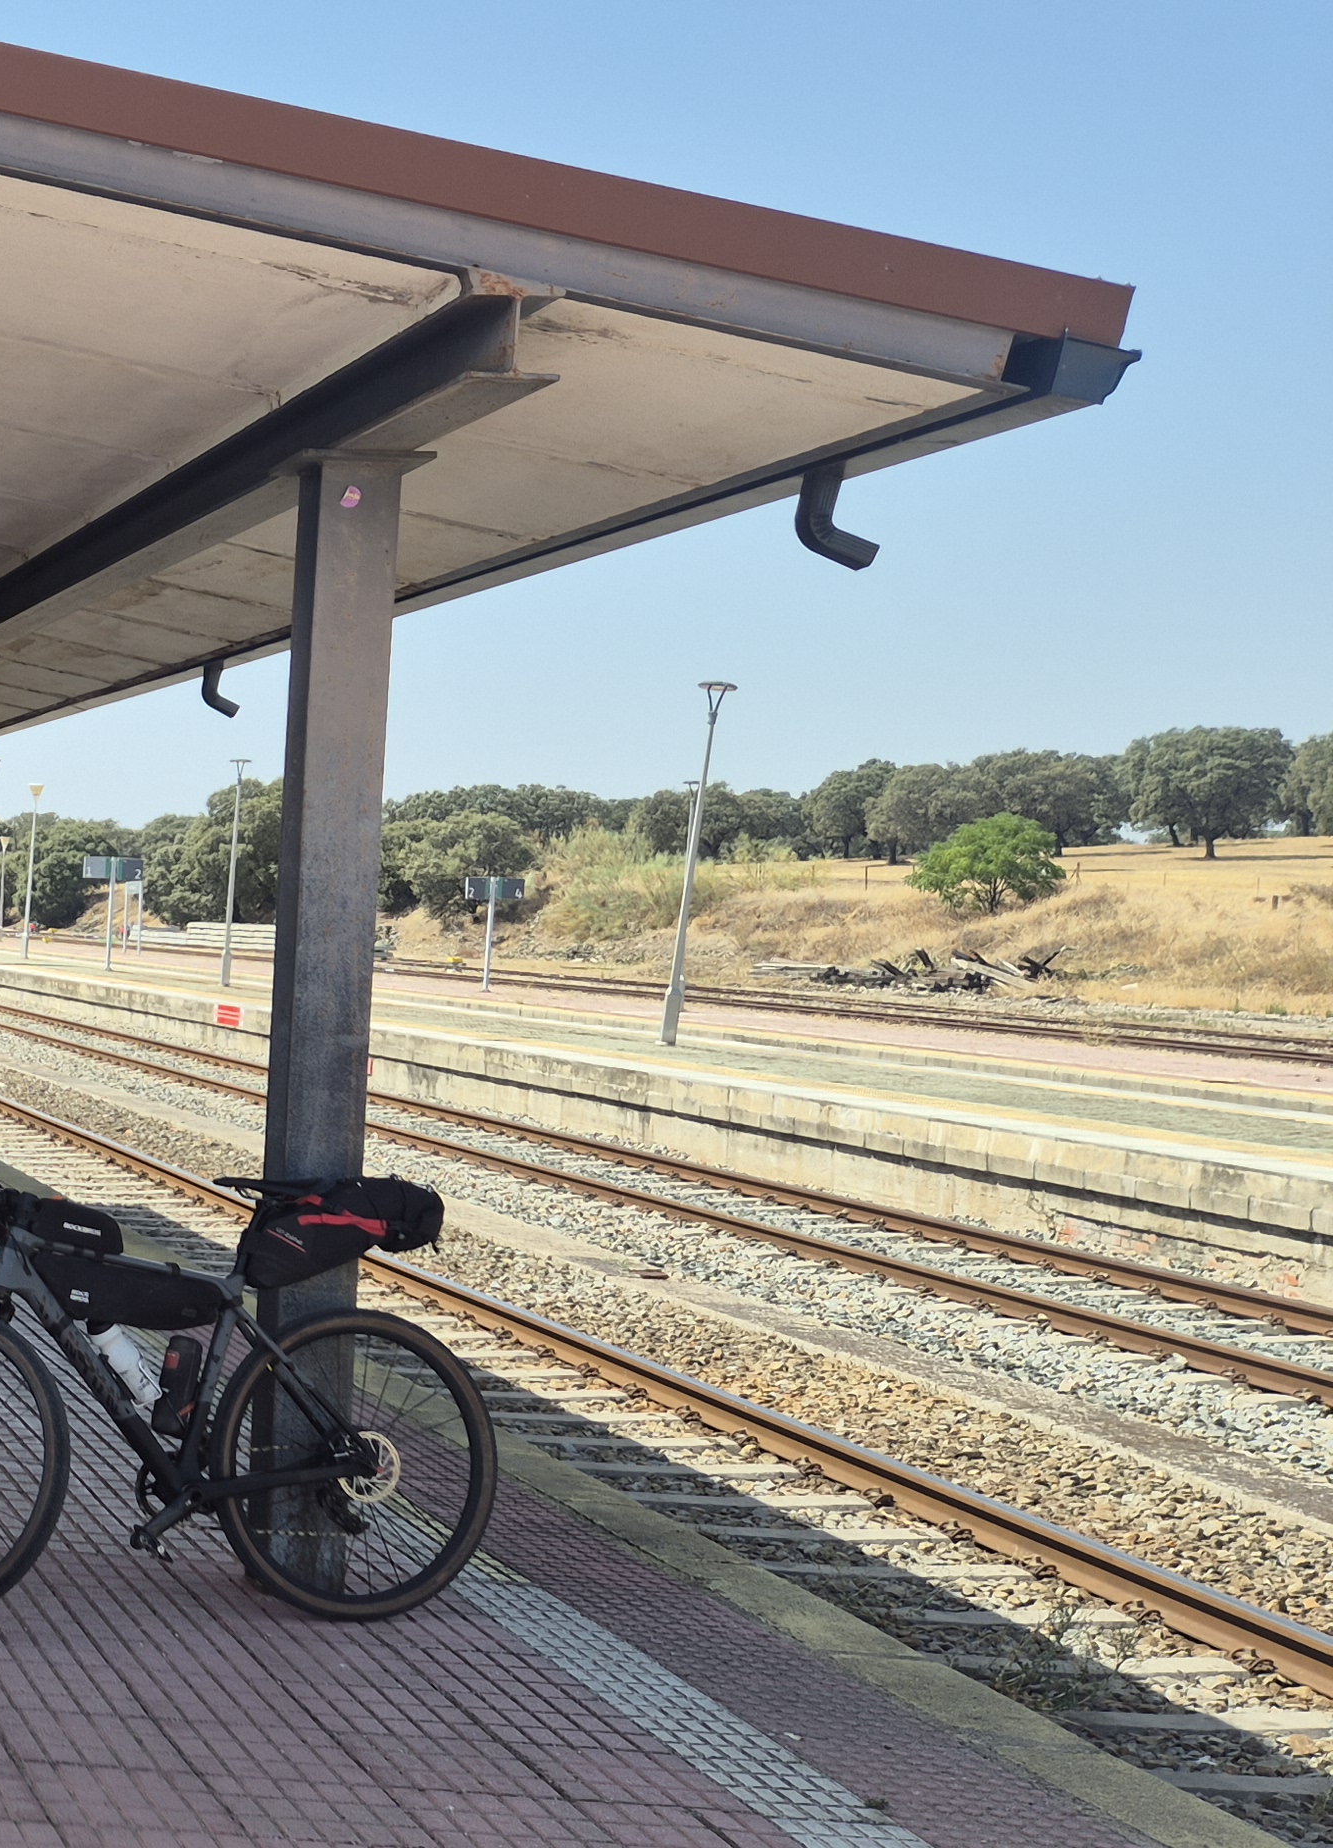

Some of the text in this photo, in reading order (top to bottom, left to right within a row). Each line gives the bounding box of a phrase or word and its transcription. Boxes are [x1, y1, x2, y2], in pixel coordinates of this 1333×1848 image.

[134, 868, 142, 880] 2
[468, 887, 475, 898] 2
[514, 888, 523, 899] 4
